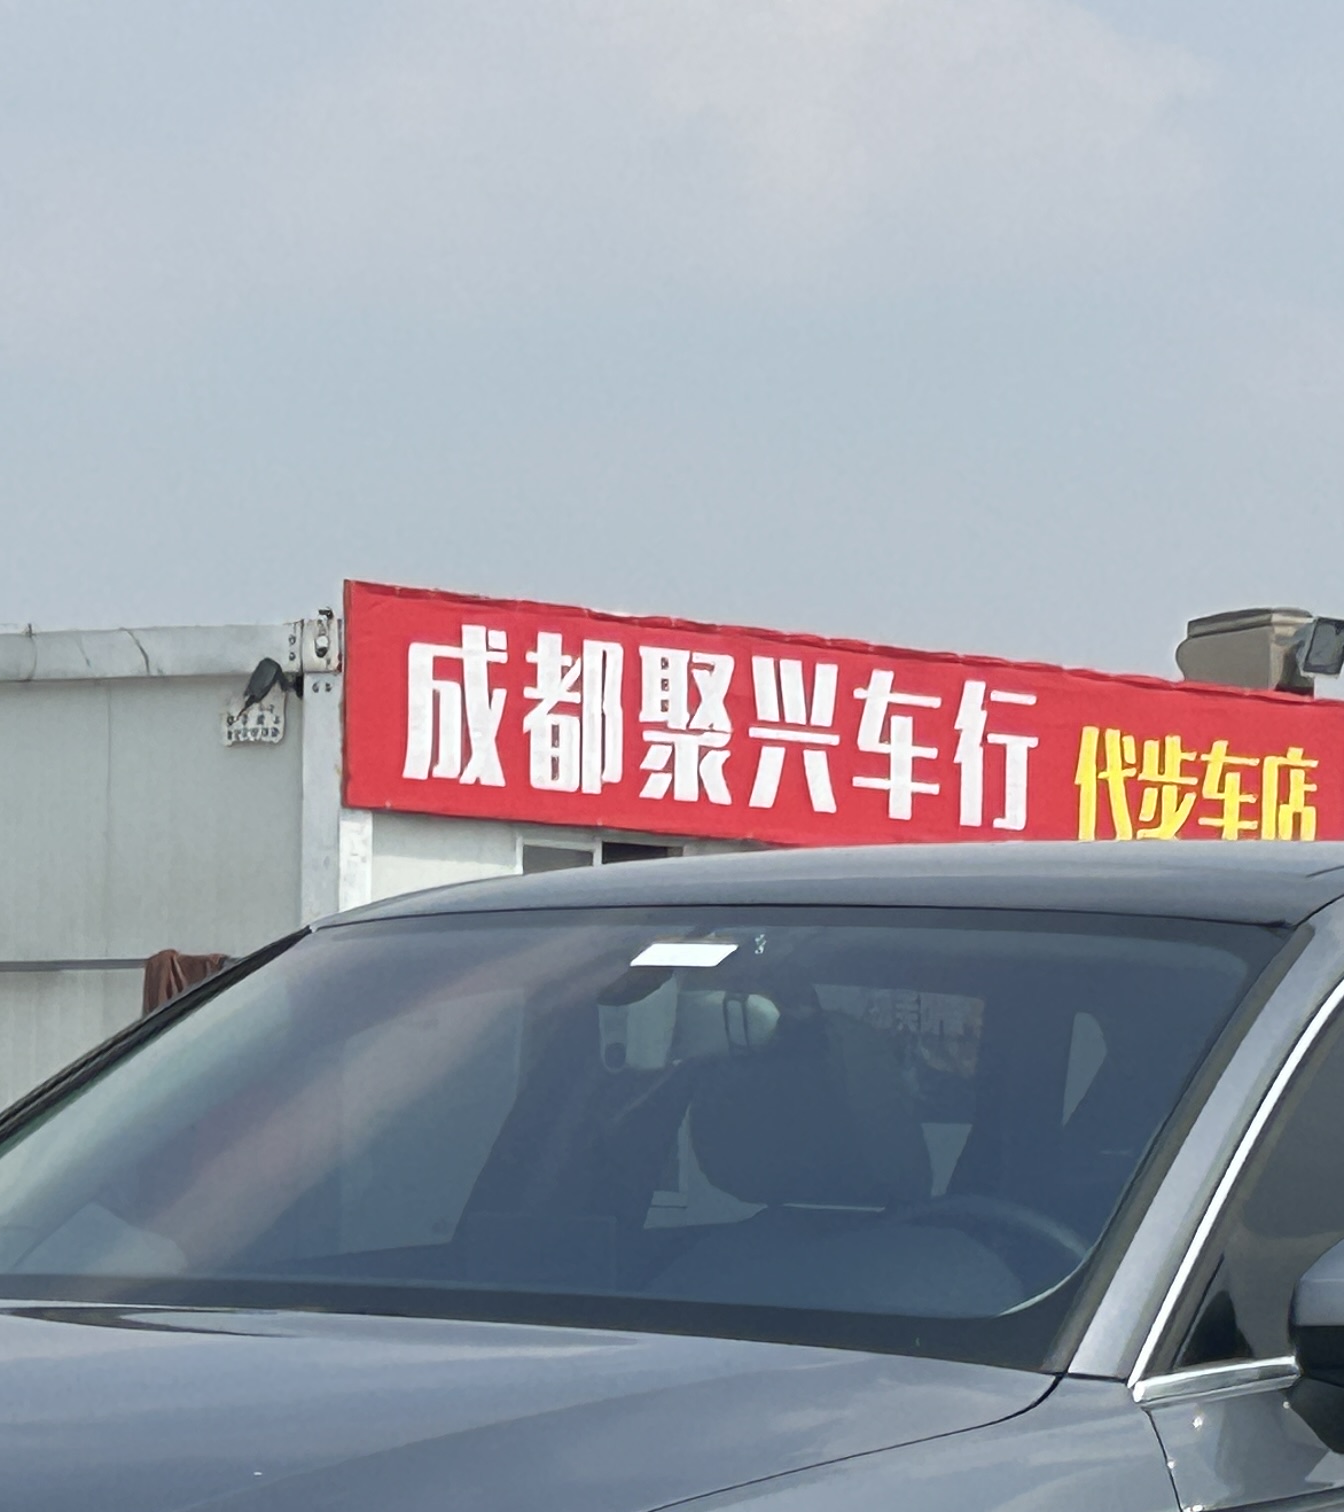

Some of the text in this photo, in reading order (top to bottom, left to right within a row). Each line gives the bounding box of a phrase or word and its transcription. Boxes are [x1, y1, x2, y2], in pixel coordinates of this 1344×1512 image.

[402, 624, 1040, 831] 成都聚兴车行
[1065, 726, 1318, 841] 代步车店
